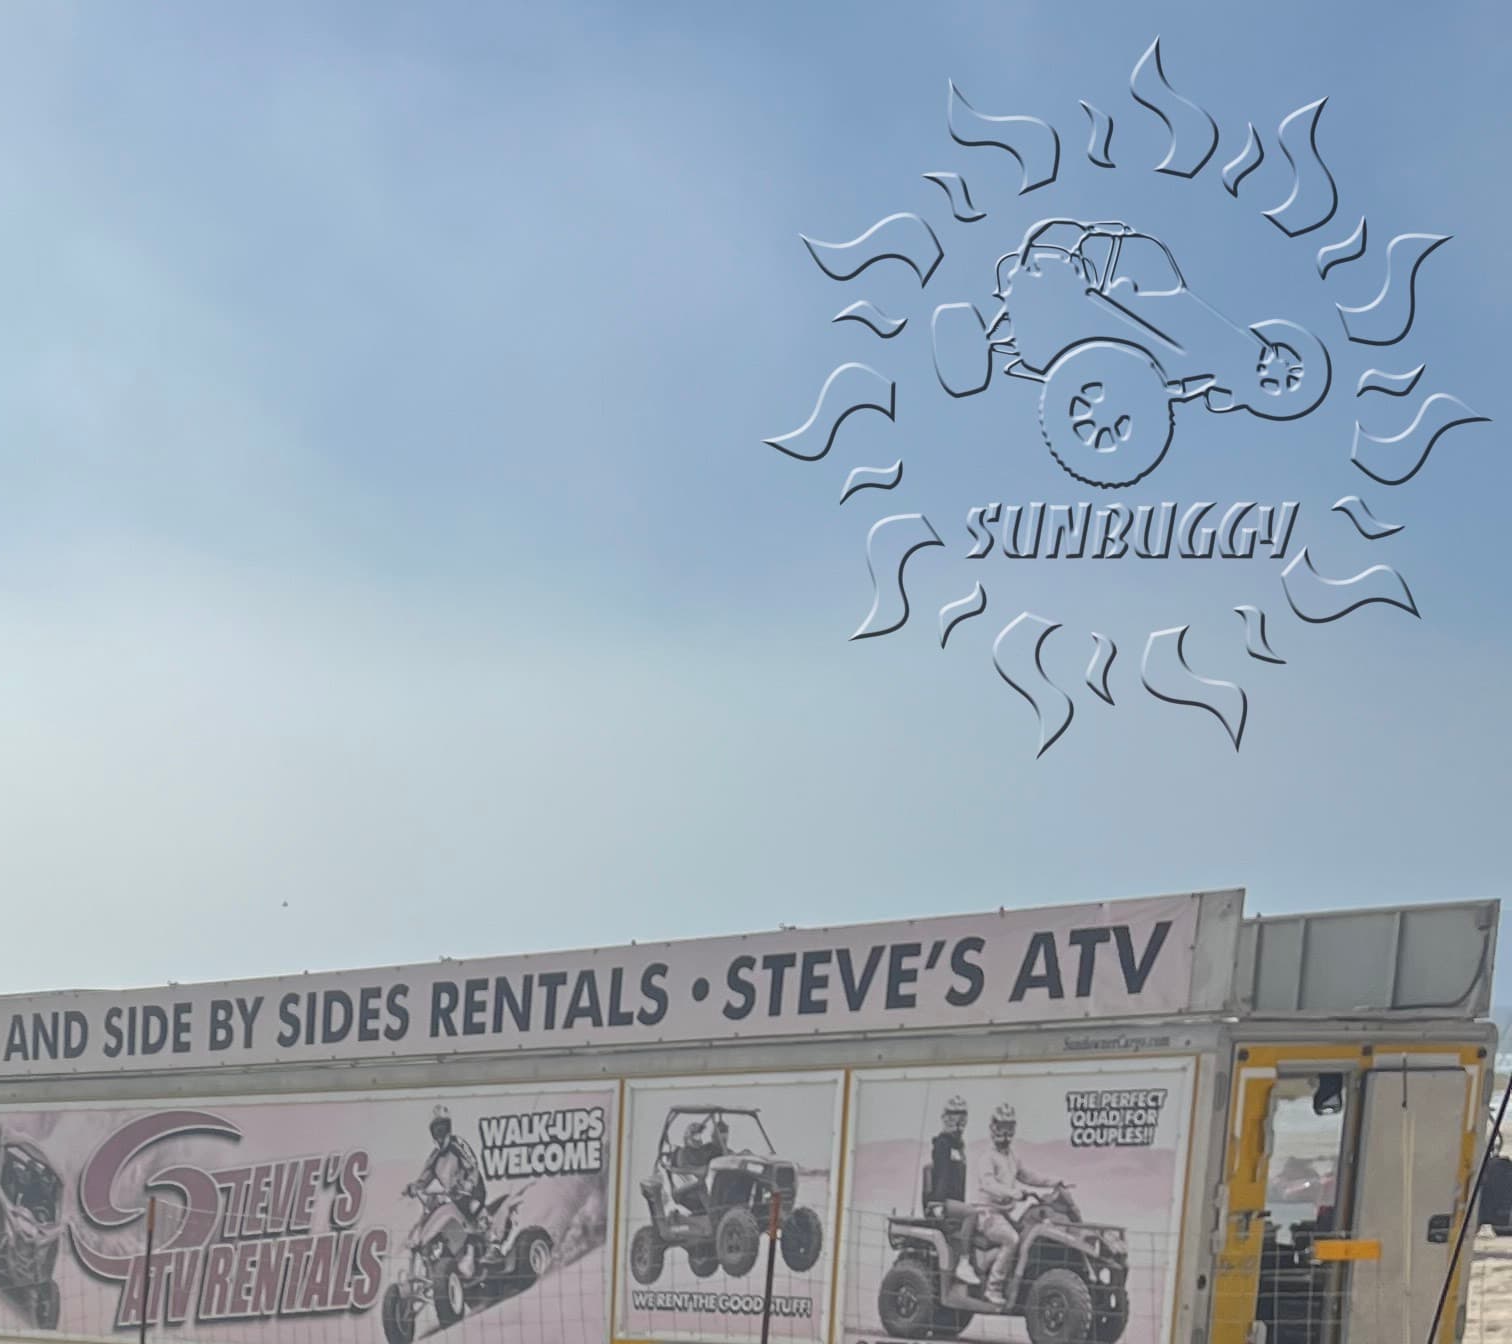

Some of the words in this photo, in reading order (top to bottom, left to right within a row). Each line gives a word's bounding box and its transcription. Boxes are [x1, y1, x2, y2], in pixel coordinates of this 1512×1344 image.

[3, 1010, 89, 1062] AND
[102, 1002, 193, 1058] SIDE
[208, 996, 265, 1051] BY
[277, 983, 410, 1048] SIDES
[430, 962, 670, 1038] RENTALS
[722, 936, 986, 1021] STEVE'S
[1008, 920, 1173, 1002] ATV
[1066, 1091, 1099, 1110] THE
[1100, 1088, 1168, 1110] PERFECT
[479, 1107, 604, 1148] WALK-UPS
[1071, 1109, 1120, 1128] QUAD
[1122, 1108, 1158, 1127] FOR
[1071, 1126, 1155, 1146] COUPLES!!
[482, 1140, 602, 1179] WELCOME
[116, 1249, 204, 1328] ATV
[197, 1228, 388, 1320] RENTALS
[632, 1290, 654, 1310] WE
[655, 1290, 689, 1311] RENT
[690, 1291, 717, 1312] THE
[717, 1293, 765, 1315] GOOD
